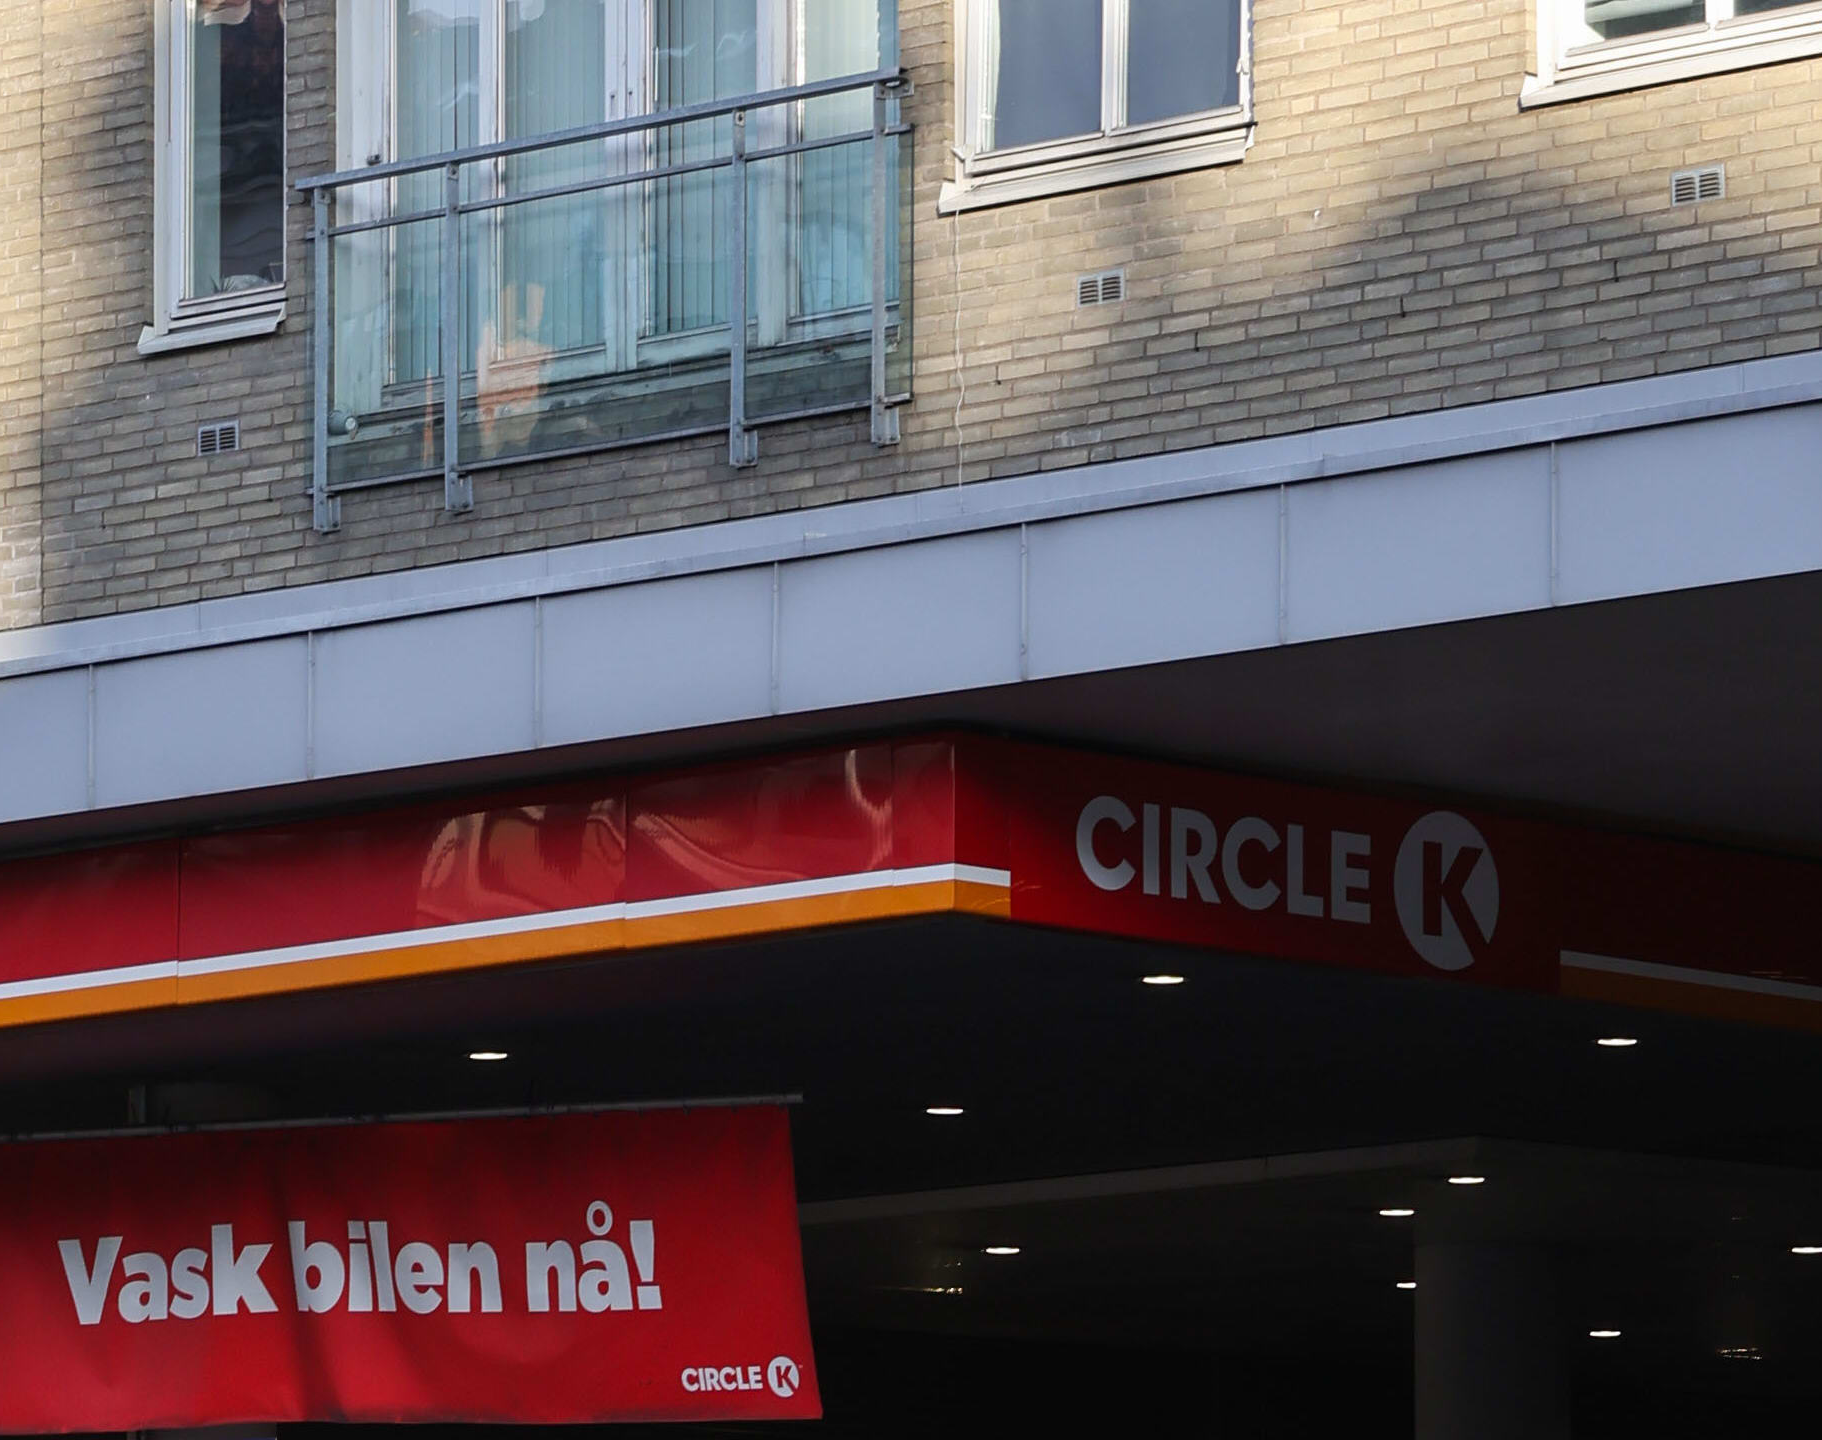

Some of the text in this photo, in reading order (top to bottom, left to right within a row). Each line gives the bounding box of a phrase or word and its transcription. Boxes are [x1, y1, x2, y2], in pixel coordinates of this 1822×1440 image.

[1075, 795, 1372, 925] CIRCLE
[56, 1199, 663, 1325] Vask bilen nå!
[680, 1365, 764, 1392] CIRCLE
